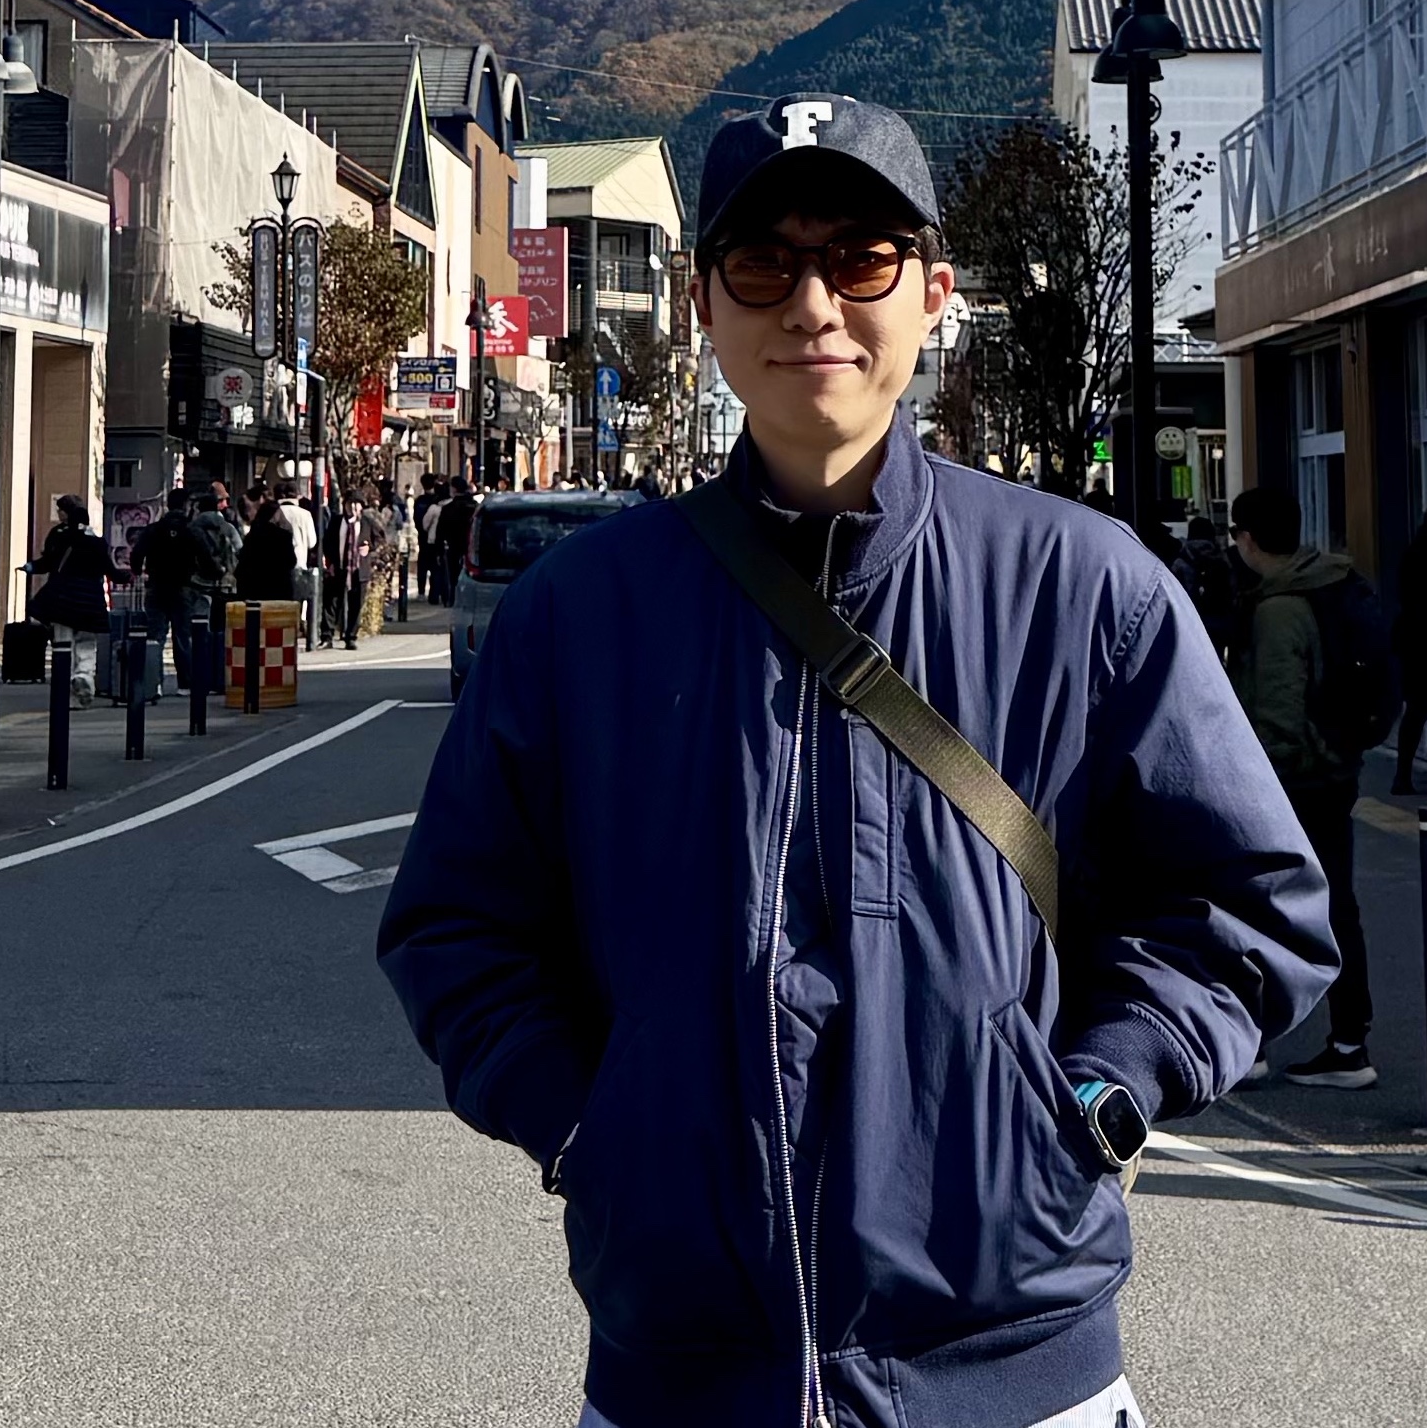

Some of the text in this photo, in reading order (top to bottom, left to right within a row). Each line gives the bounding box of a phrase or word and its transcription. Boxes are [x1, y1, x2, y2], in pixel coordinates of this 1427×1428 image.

[781, 101, 833, 151] F
[298, 234, 313, 328] バスのりば
